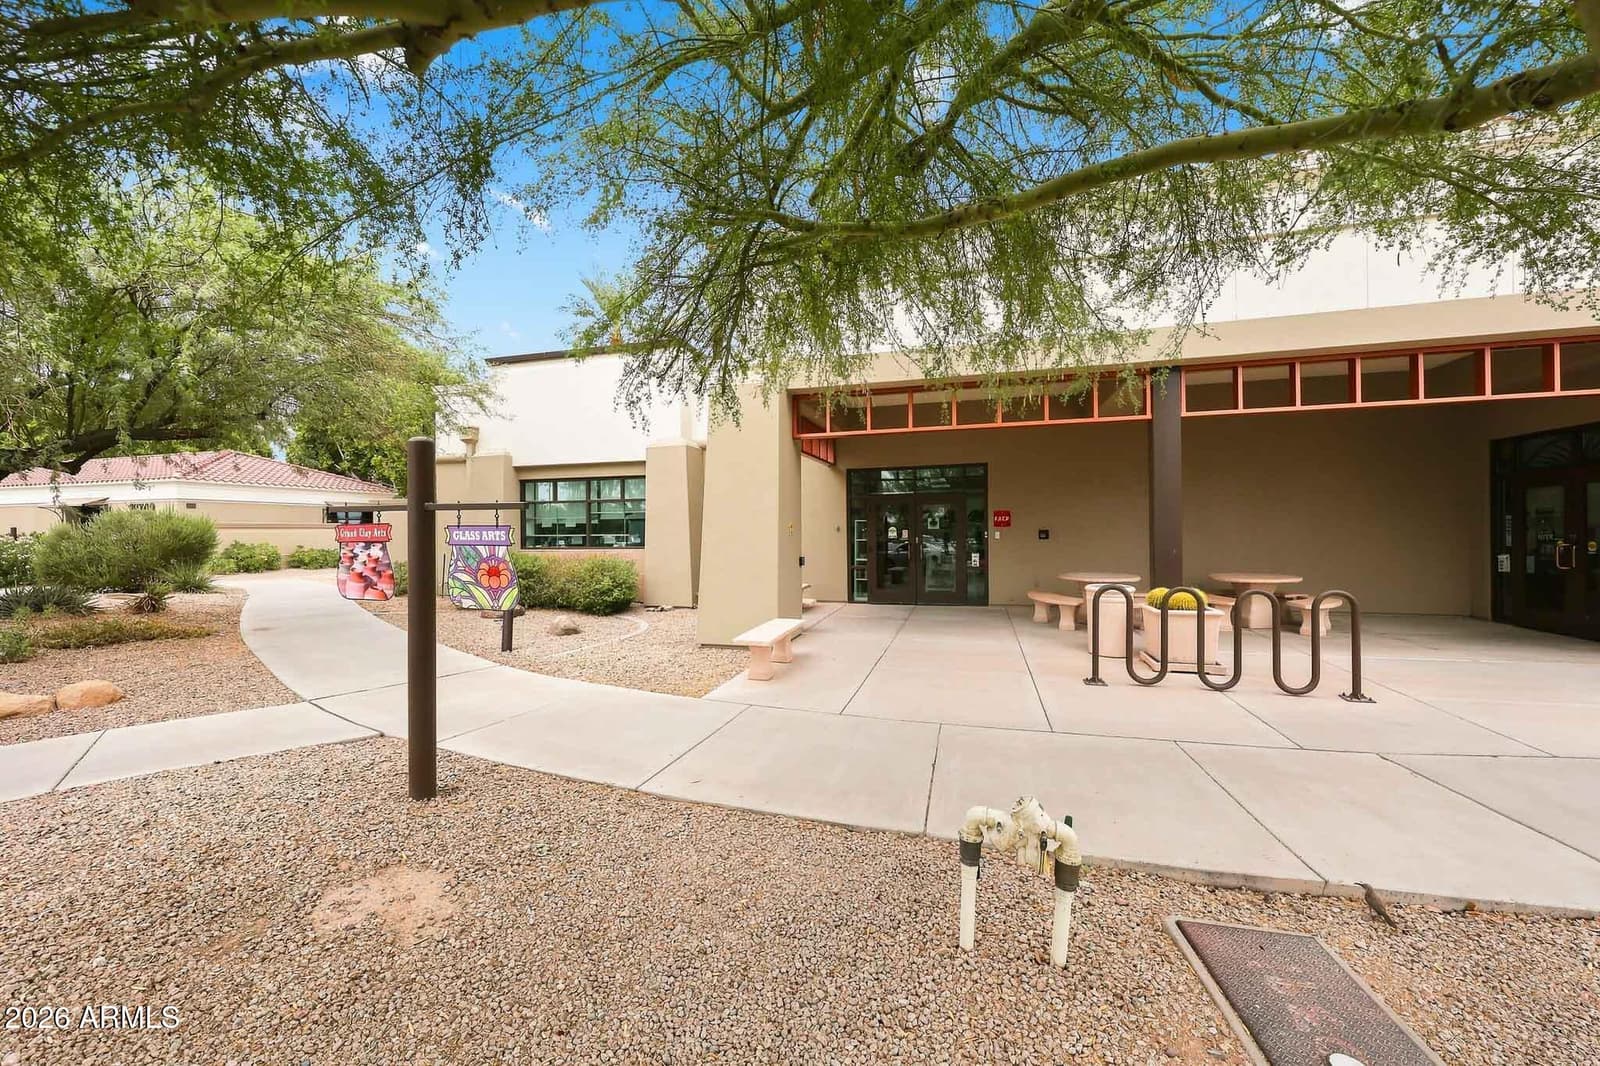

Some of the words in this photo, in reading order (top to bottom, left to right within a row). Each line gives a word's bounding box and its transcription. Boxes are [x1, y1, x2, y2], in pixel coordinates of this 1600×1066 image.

[359, 528, 371, 539] Clay
[373, 528, 387, 538] Arts
[452, 530, 480, 541] GLASS
[481, 530, 506, 541] ARTS
